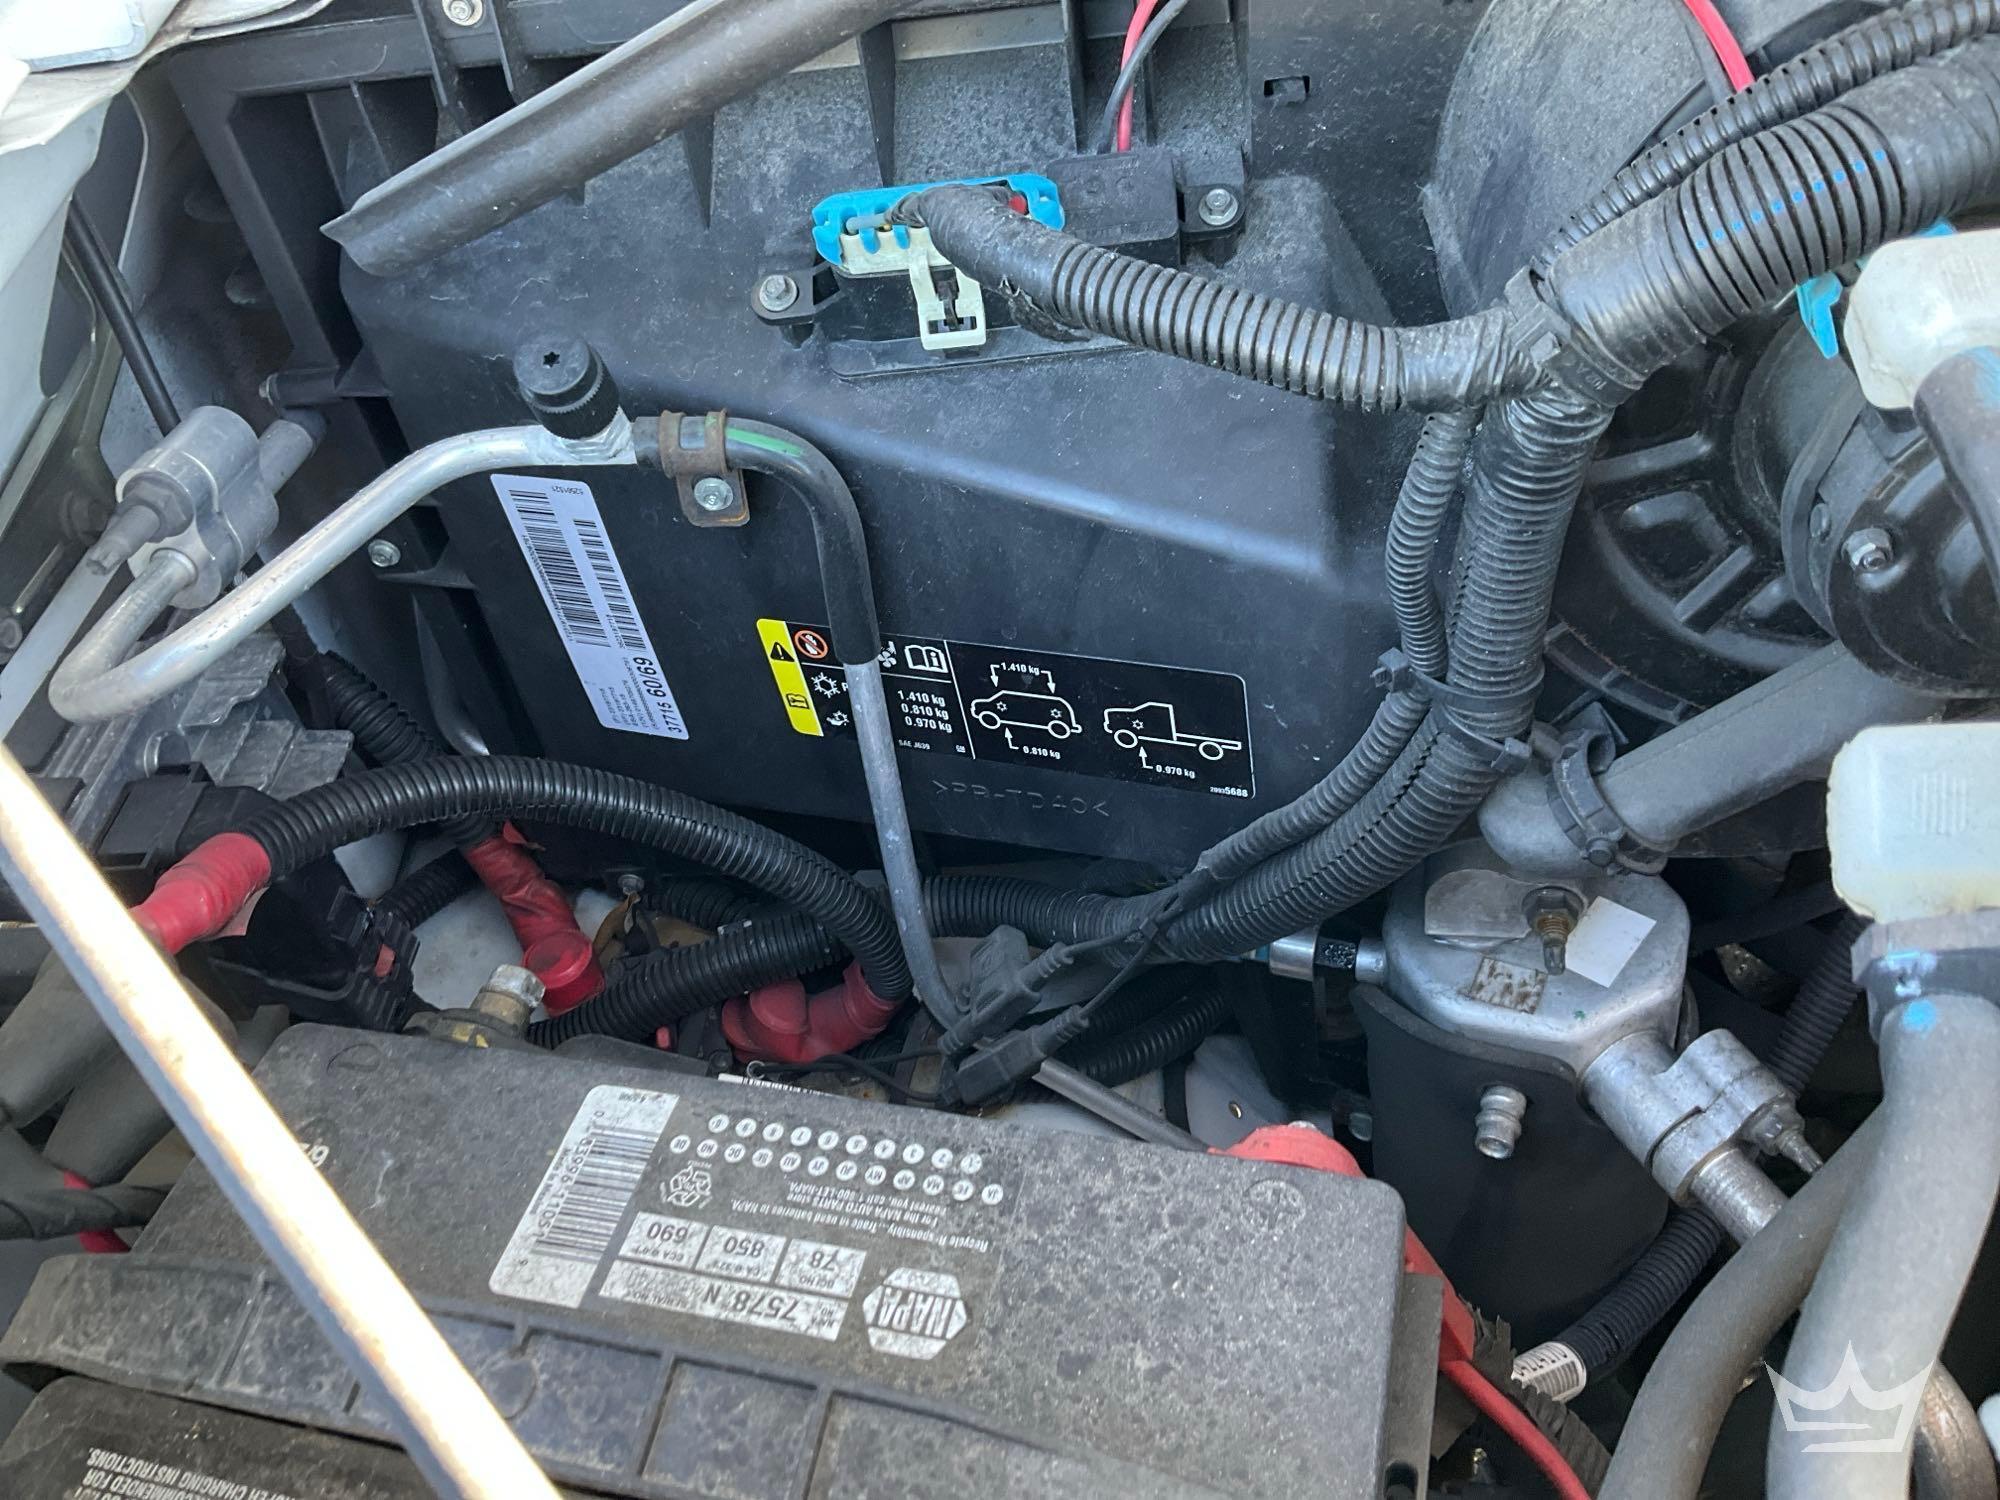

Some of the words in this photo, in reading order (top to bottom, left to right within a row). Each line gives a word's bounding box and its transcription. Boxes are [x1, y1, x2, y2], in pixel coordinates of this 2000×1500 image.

[633, 657, 666, 698] 60/69
[998, 662, 1027, 674] 1.410
[1028, 665, 1040, 676] kg
[897, 690, 930, 703] 1.410
[931, 694, 946, 707] kg
[657, 702, 682, 732] 37715
[901, 703, 933, 717] 0.810
[935, 708, 949, 720] kg
[905, 716, 936, 730] 0.970
[939, 721, 952, 733] kg
[1022, 745, 1048, 757] 0.810
[1049, 749, 1061, 760] kg
[1155, 764, 1182, 776] 0.970
[1184, 768, 1196, 779] kg
[561, 1138, 593, 1182] 83996
[787, 1192, 811, 1203] store
[812, 1196, 844, 1210] PARTS
[532, 1192, 564, 1237] 11051
[771, 1206, 813, 1222] batteries
[845, 1201, 873, 1215] AUTO
[873, 1206, 902, 1219] NAPA
[816, 1213, 838, 1225] used
[903, 1212, 919, 1224] the
[920, 1215, 938, 1227] For
[647, 1221, 689, 1243] 690
[723, 1236, 765, 1258] 850
[950, 1233, 989, 1252] Recycle
[809, 1249, 839, 1271] 78
[703, 1283, 721, 1303] N
[732, 1291, 800, 1321] 7578
[877, 1286, 953, 1338] NAPA
[87, 1447, 180, 1486] INSTRUCTIONS.
[82, 1468, 113, 1489] FOR
[110, 1475, 212, 1500] COMMENDED
[178, 1471, 249, 1500] CHARGING
